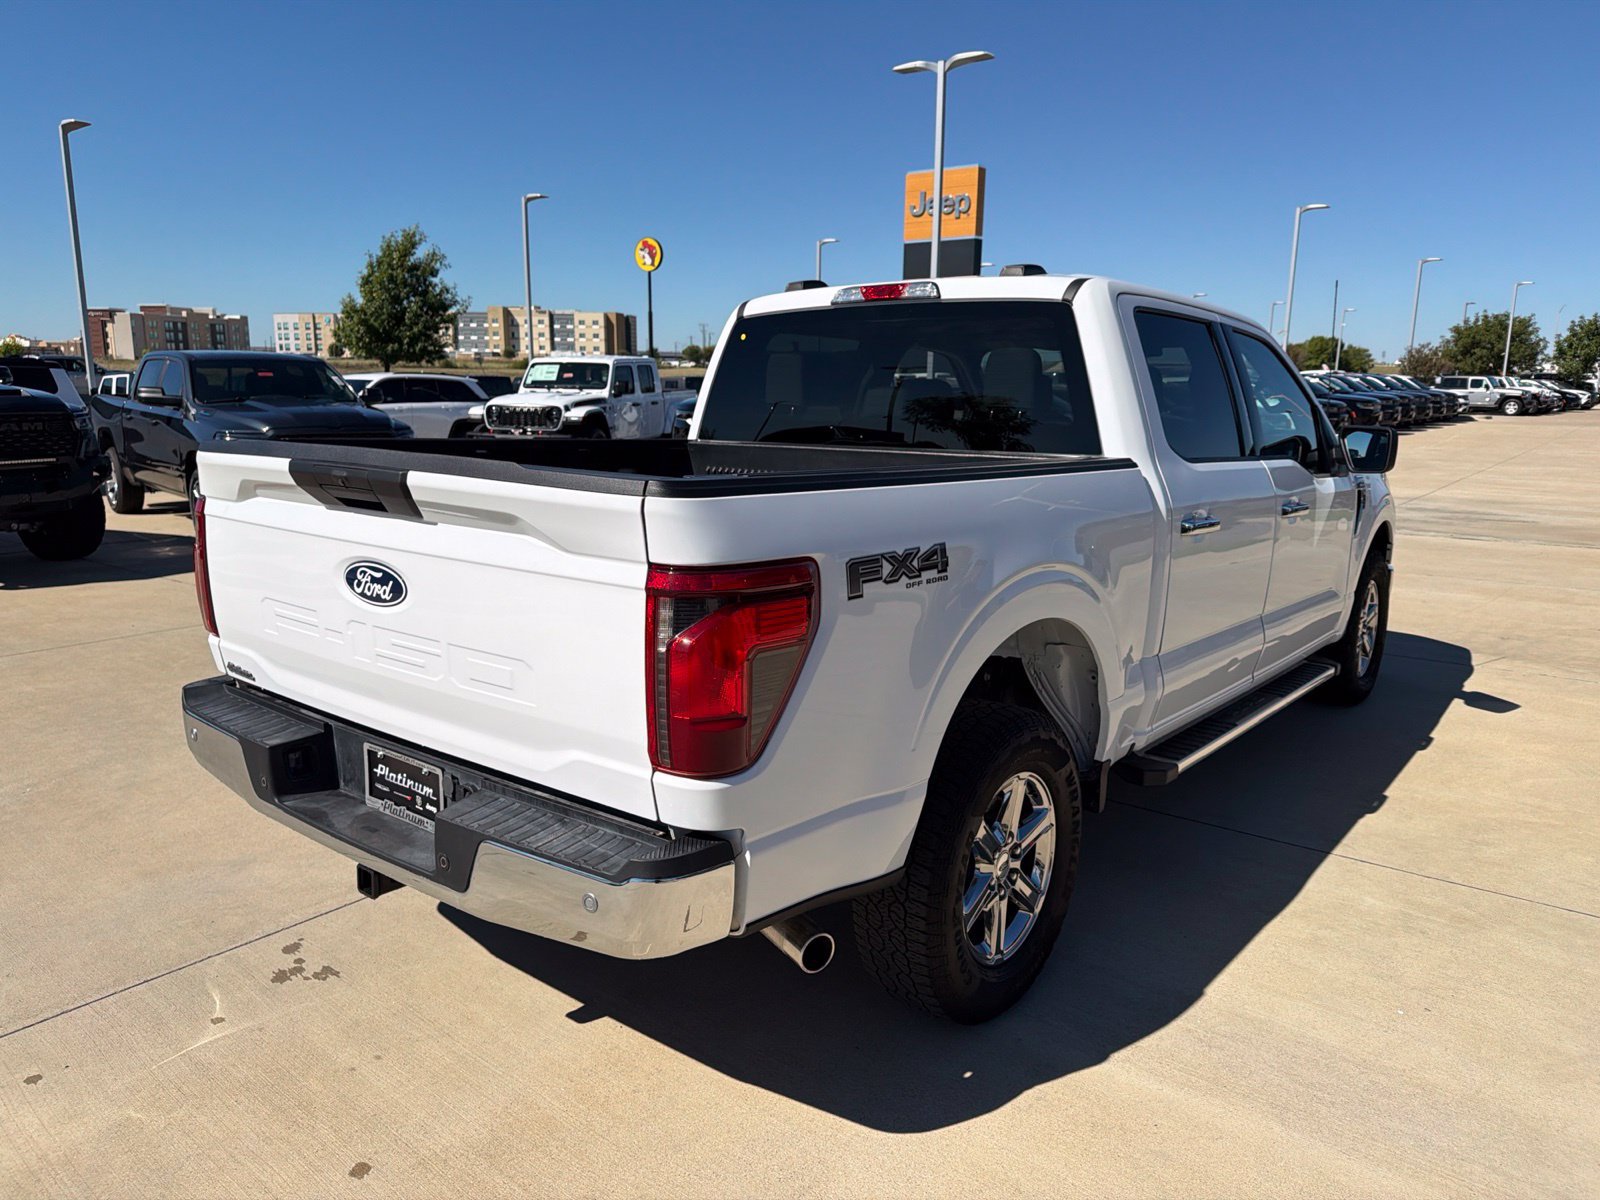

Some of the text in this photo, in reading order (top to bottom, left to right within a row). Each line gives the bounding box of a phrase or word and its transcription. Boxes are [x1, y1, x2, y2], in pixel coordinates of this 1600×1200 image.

[0, 422, 43, 432] AM
[353, 566, 394, 601] Ford
[846, 542, 949, 600] FX4
[905, 575, 949, 589] OFF ROAD
[260, 596, 537, 708] F-150
[373, 764, 437, 800] Platinum
[383, 800, 428, 828] Platinum
